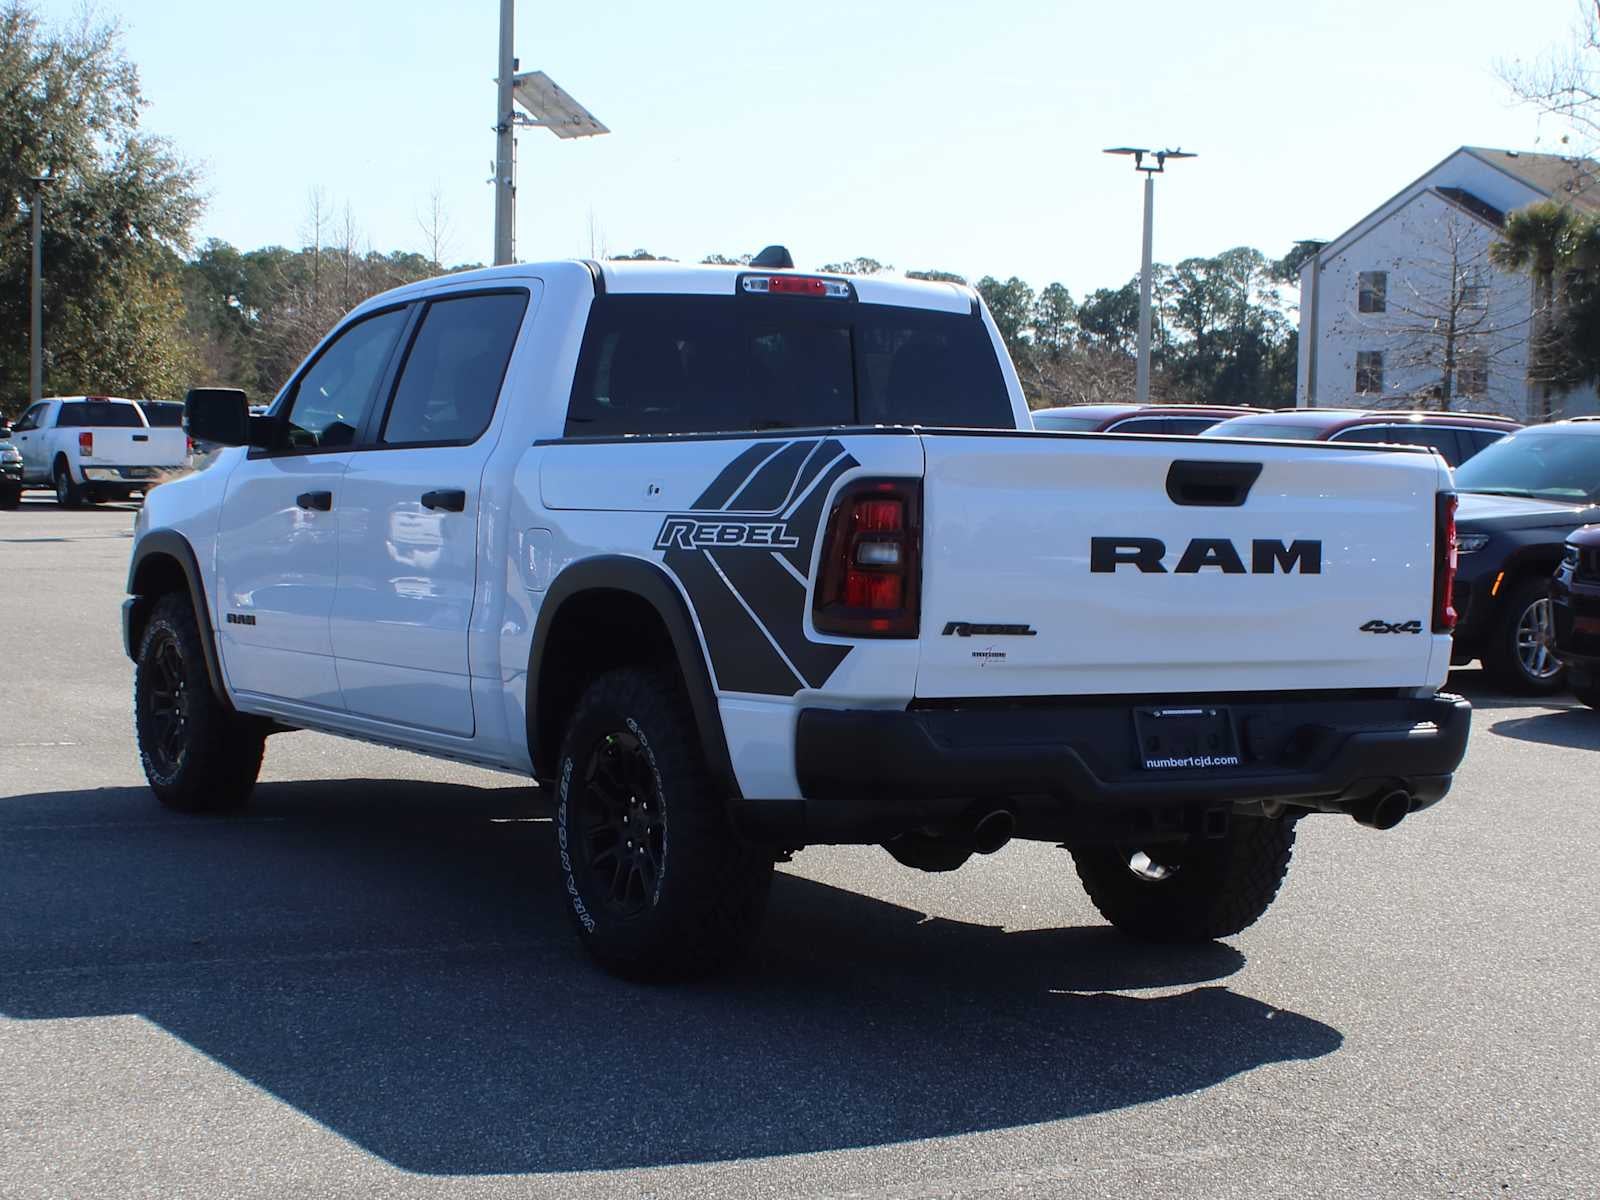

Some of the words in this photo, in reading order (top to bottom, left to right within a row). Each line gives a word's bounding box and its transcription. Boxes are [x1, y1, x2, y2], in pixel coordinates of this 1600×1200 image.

[656, 518, 799, 549] REBEL
[1090, 536, 1322, 574] RAM
[227, 613, 256, 626] RAM
[1359, 620, 1423, 634] 4x4
[1146, 756, 1238, 768] number1cjd.com
